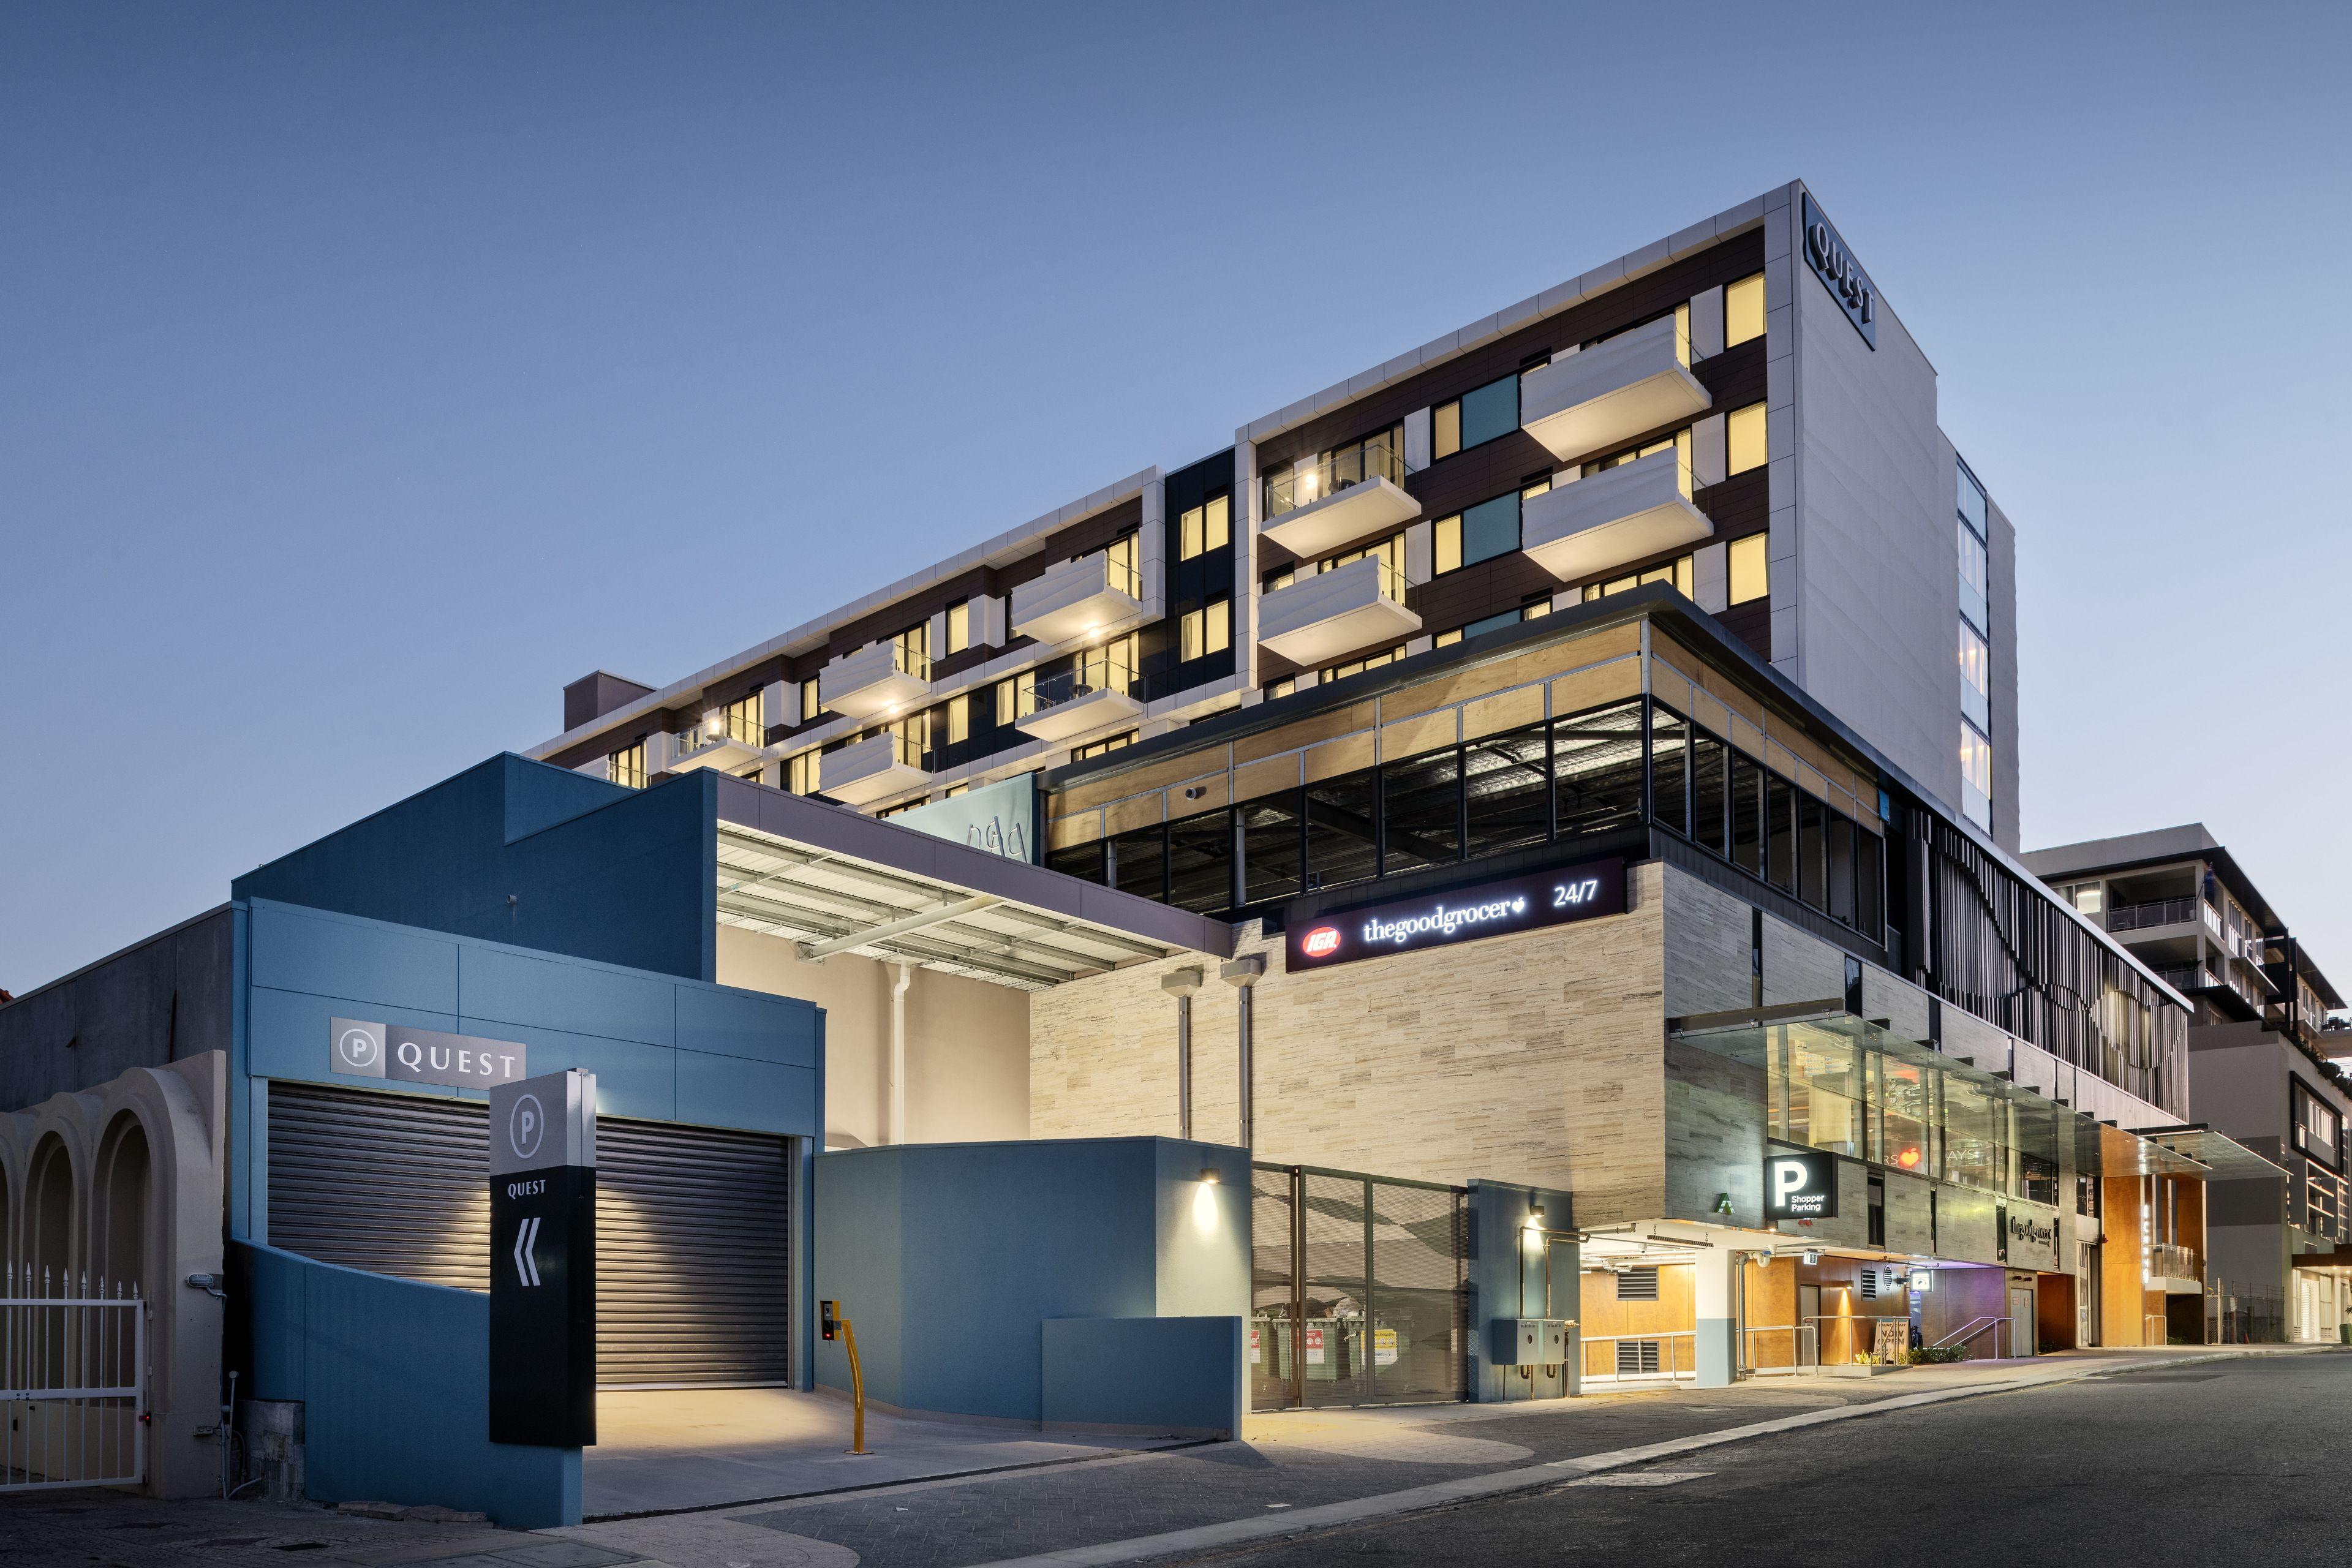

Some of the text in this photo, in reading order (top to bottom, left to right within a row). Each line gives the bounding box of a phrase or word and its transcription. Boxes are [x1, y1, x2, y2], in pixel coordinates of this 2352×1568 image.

[1808, 222, 1874, 323] QUEST
[1364, 900, 1510, 942] thegoodgrocer
[1555, 880, 1597, 906] 24/7
[353, 1038, 515, 1078] P QUEST
[521, 1110, 534, 1144] P
[1946, 1149, 1975, 1161] AYS
[508, 1180, 546, 1200] QUEST
[1775, 1161, 1807, 1206] P
[1792, 1195, 1825, 1204] Shopper
